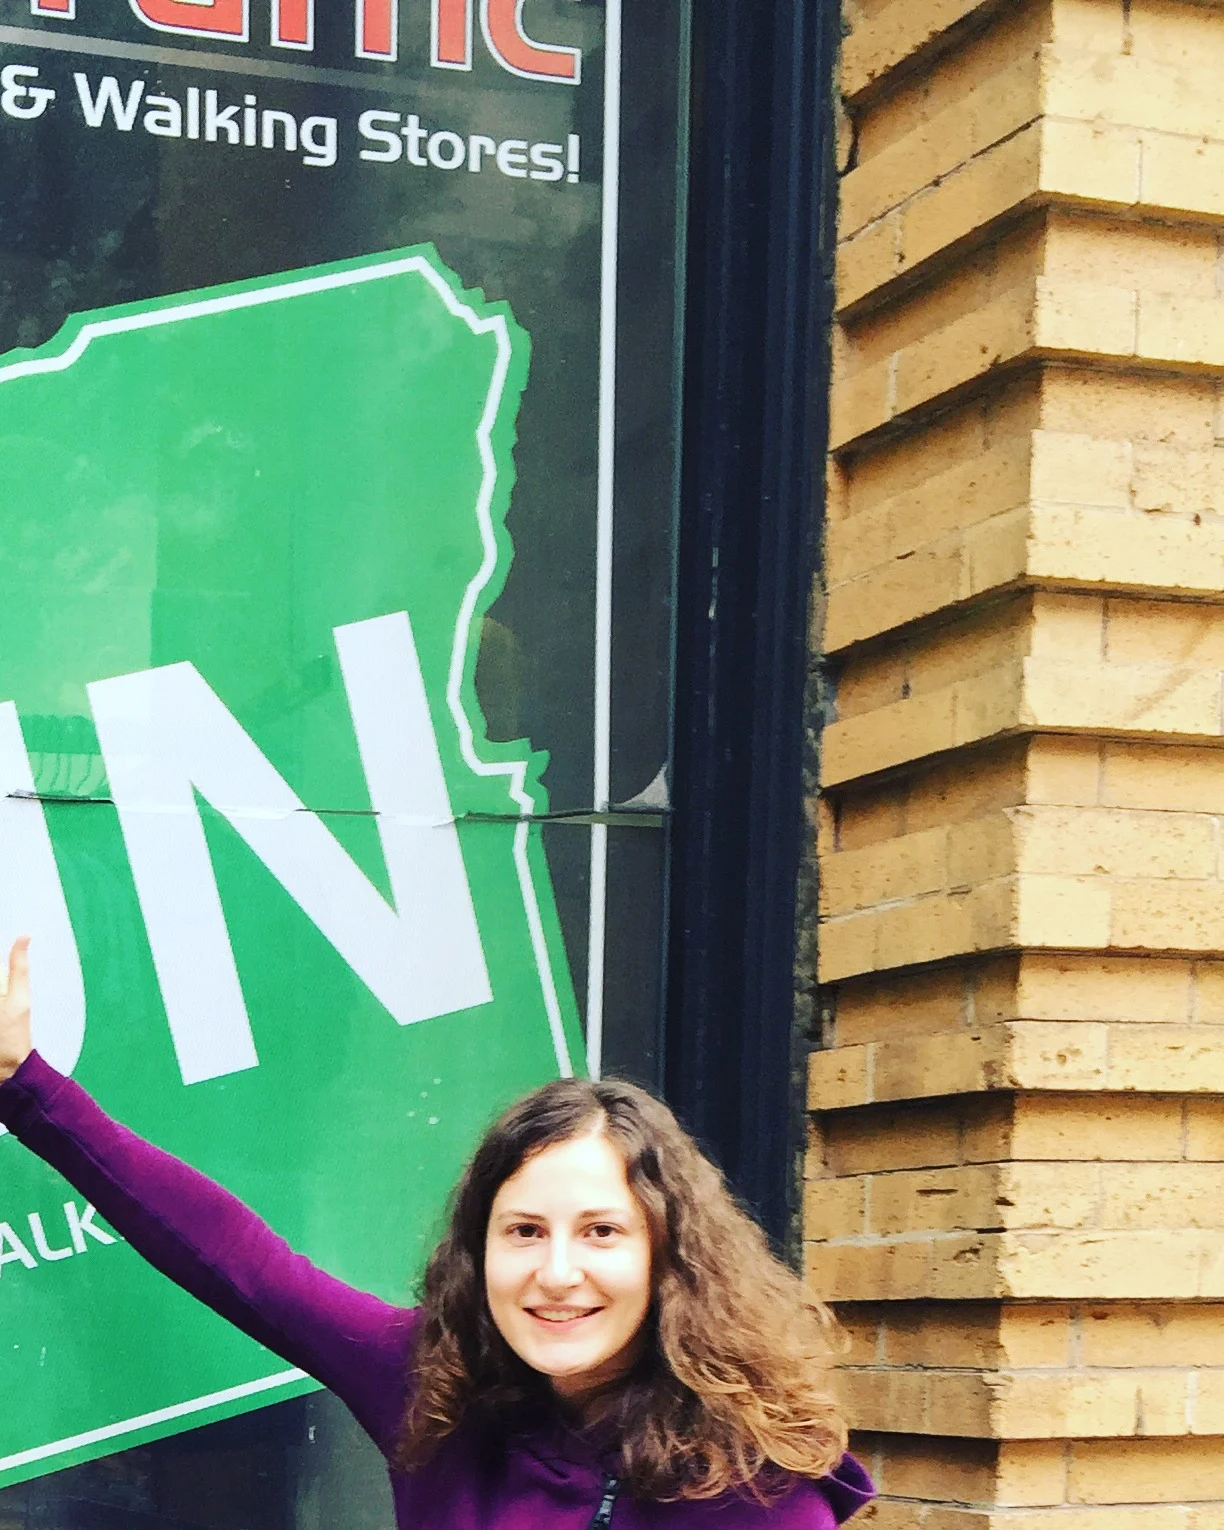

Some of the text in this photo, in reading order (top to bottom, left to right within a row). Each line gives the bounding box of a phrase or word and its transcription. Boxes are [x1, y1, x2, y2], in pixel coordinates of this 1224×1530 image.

[0, 64, 56, 119] &
[74, 73, 337, 167] Walking
[358, 110, 580, 183] Stores!
